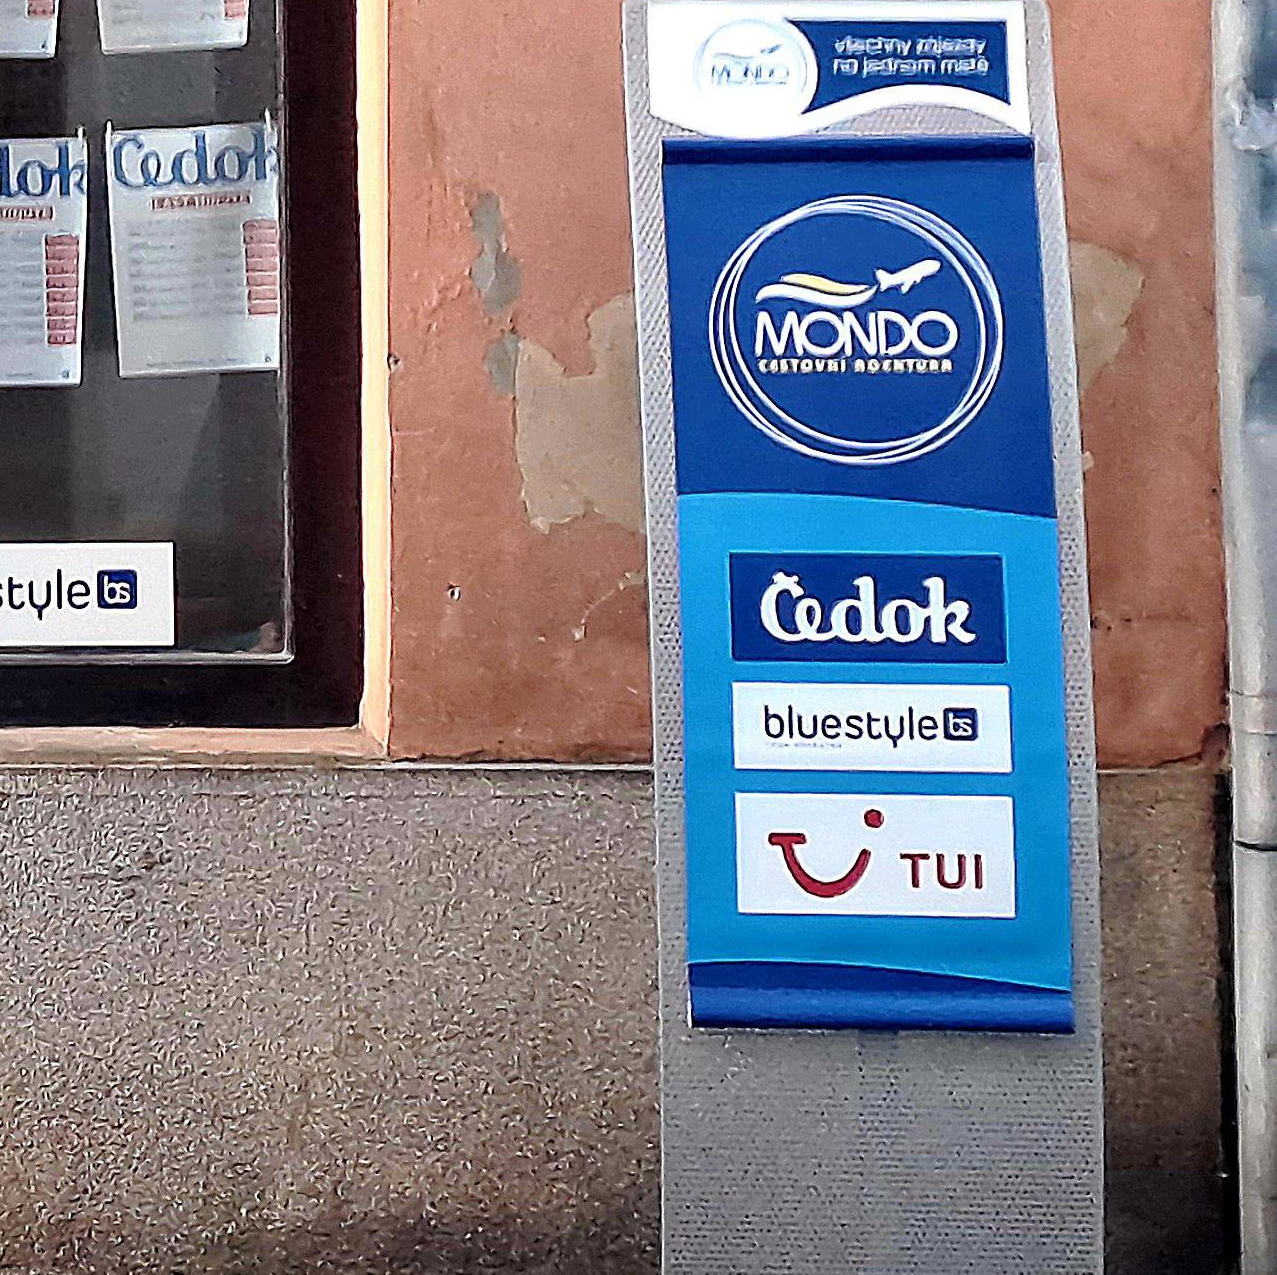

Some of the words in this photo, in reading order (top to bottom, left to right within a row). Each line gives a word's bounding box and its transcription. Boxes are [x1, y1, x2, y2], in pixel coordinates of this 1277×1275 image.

[754, 310, 960, 358] MONDO
[760, 571, 976, 644] Čedok
[764, 704, 939, 749] bluestyle
[900, 853, 984, 890] TUI
